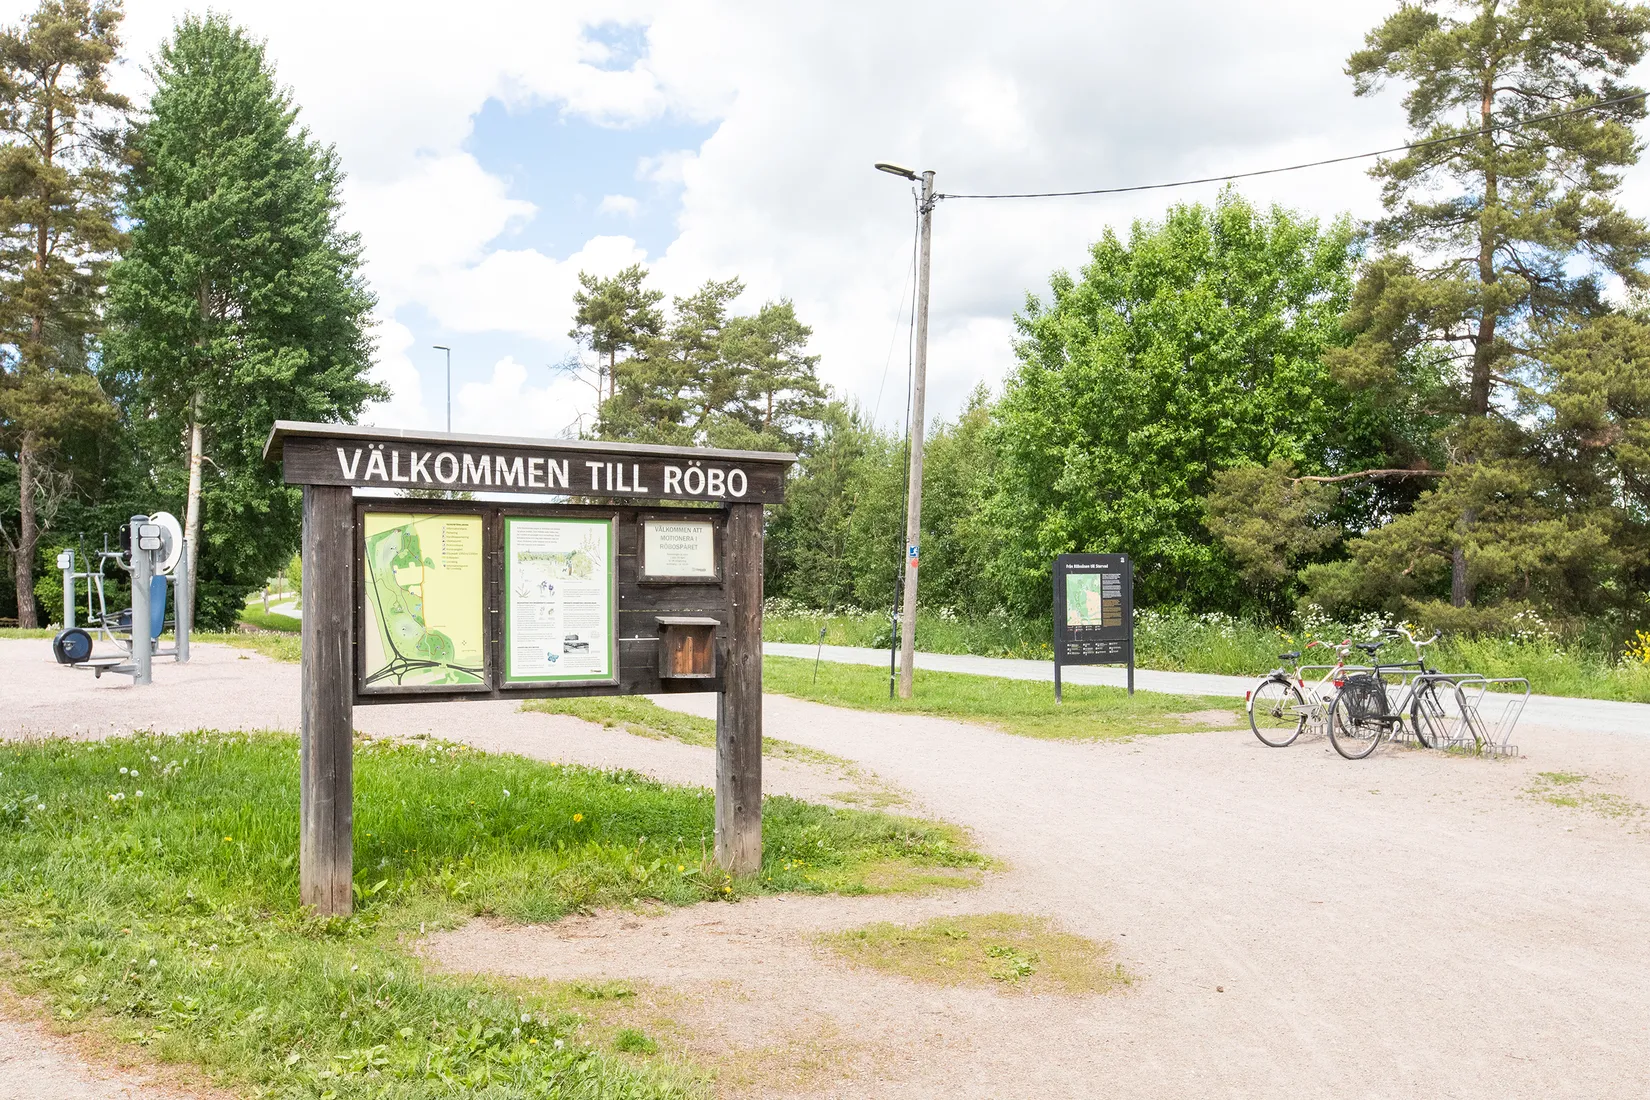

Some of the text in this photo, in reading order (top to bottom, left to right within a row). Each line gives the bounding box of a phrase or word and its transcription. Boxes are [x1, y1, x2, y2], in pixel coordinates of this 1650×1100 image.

[337, 443, 748, 497] VÄLKOMMEN TILL RÖBO
